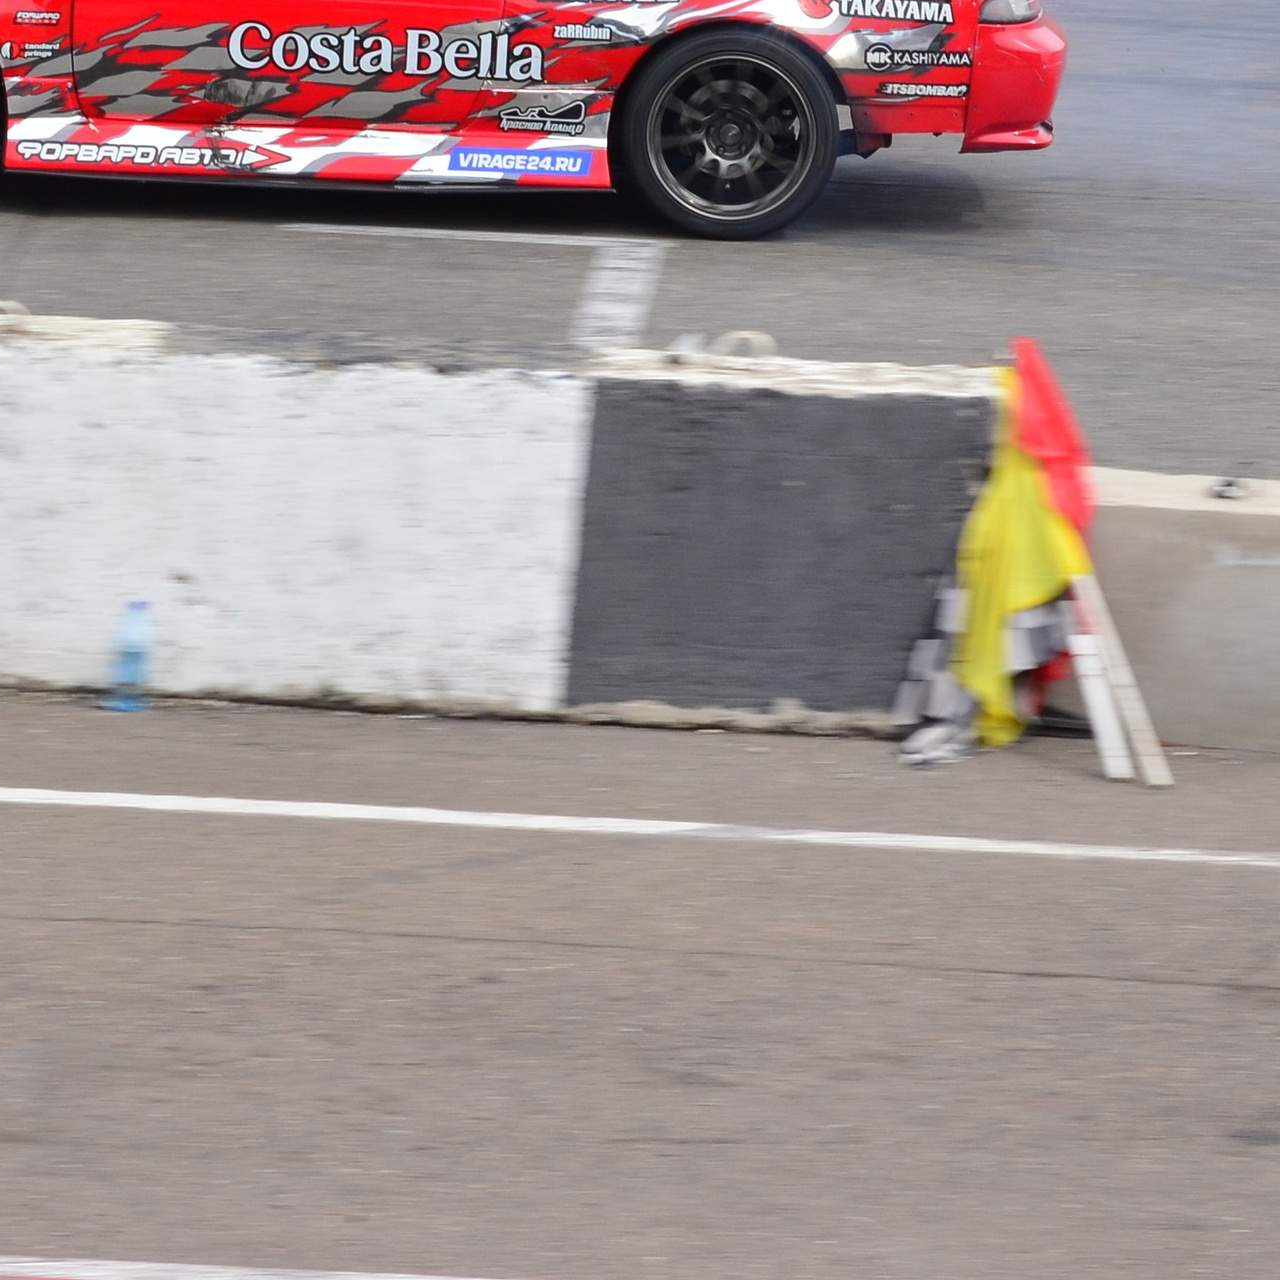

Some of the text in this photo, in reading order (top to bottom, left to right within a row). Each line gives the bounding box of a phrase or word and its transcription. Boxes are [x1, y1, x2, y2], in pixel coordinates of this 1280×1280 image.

[16, 11, 60, 20] FORWARD
[227, 21, 544, 81] Costa Bella
[894, 52, 970, 65] KASHIYAMA
[18, 142, 155, 163] ФОРВАРД
[459, 153, 582, 172] VIRAGE24.RU
